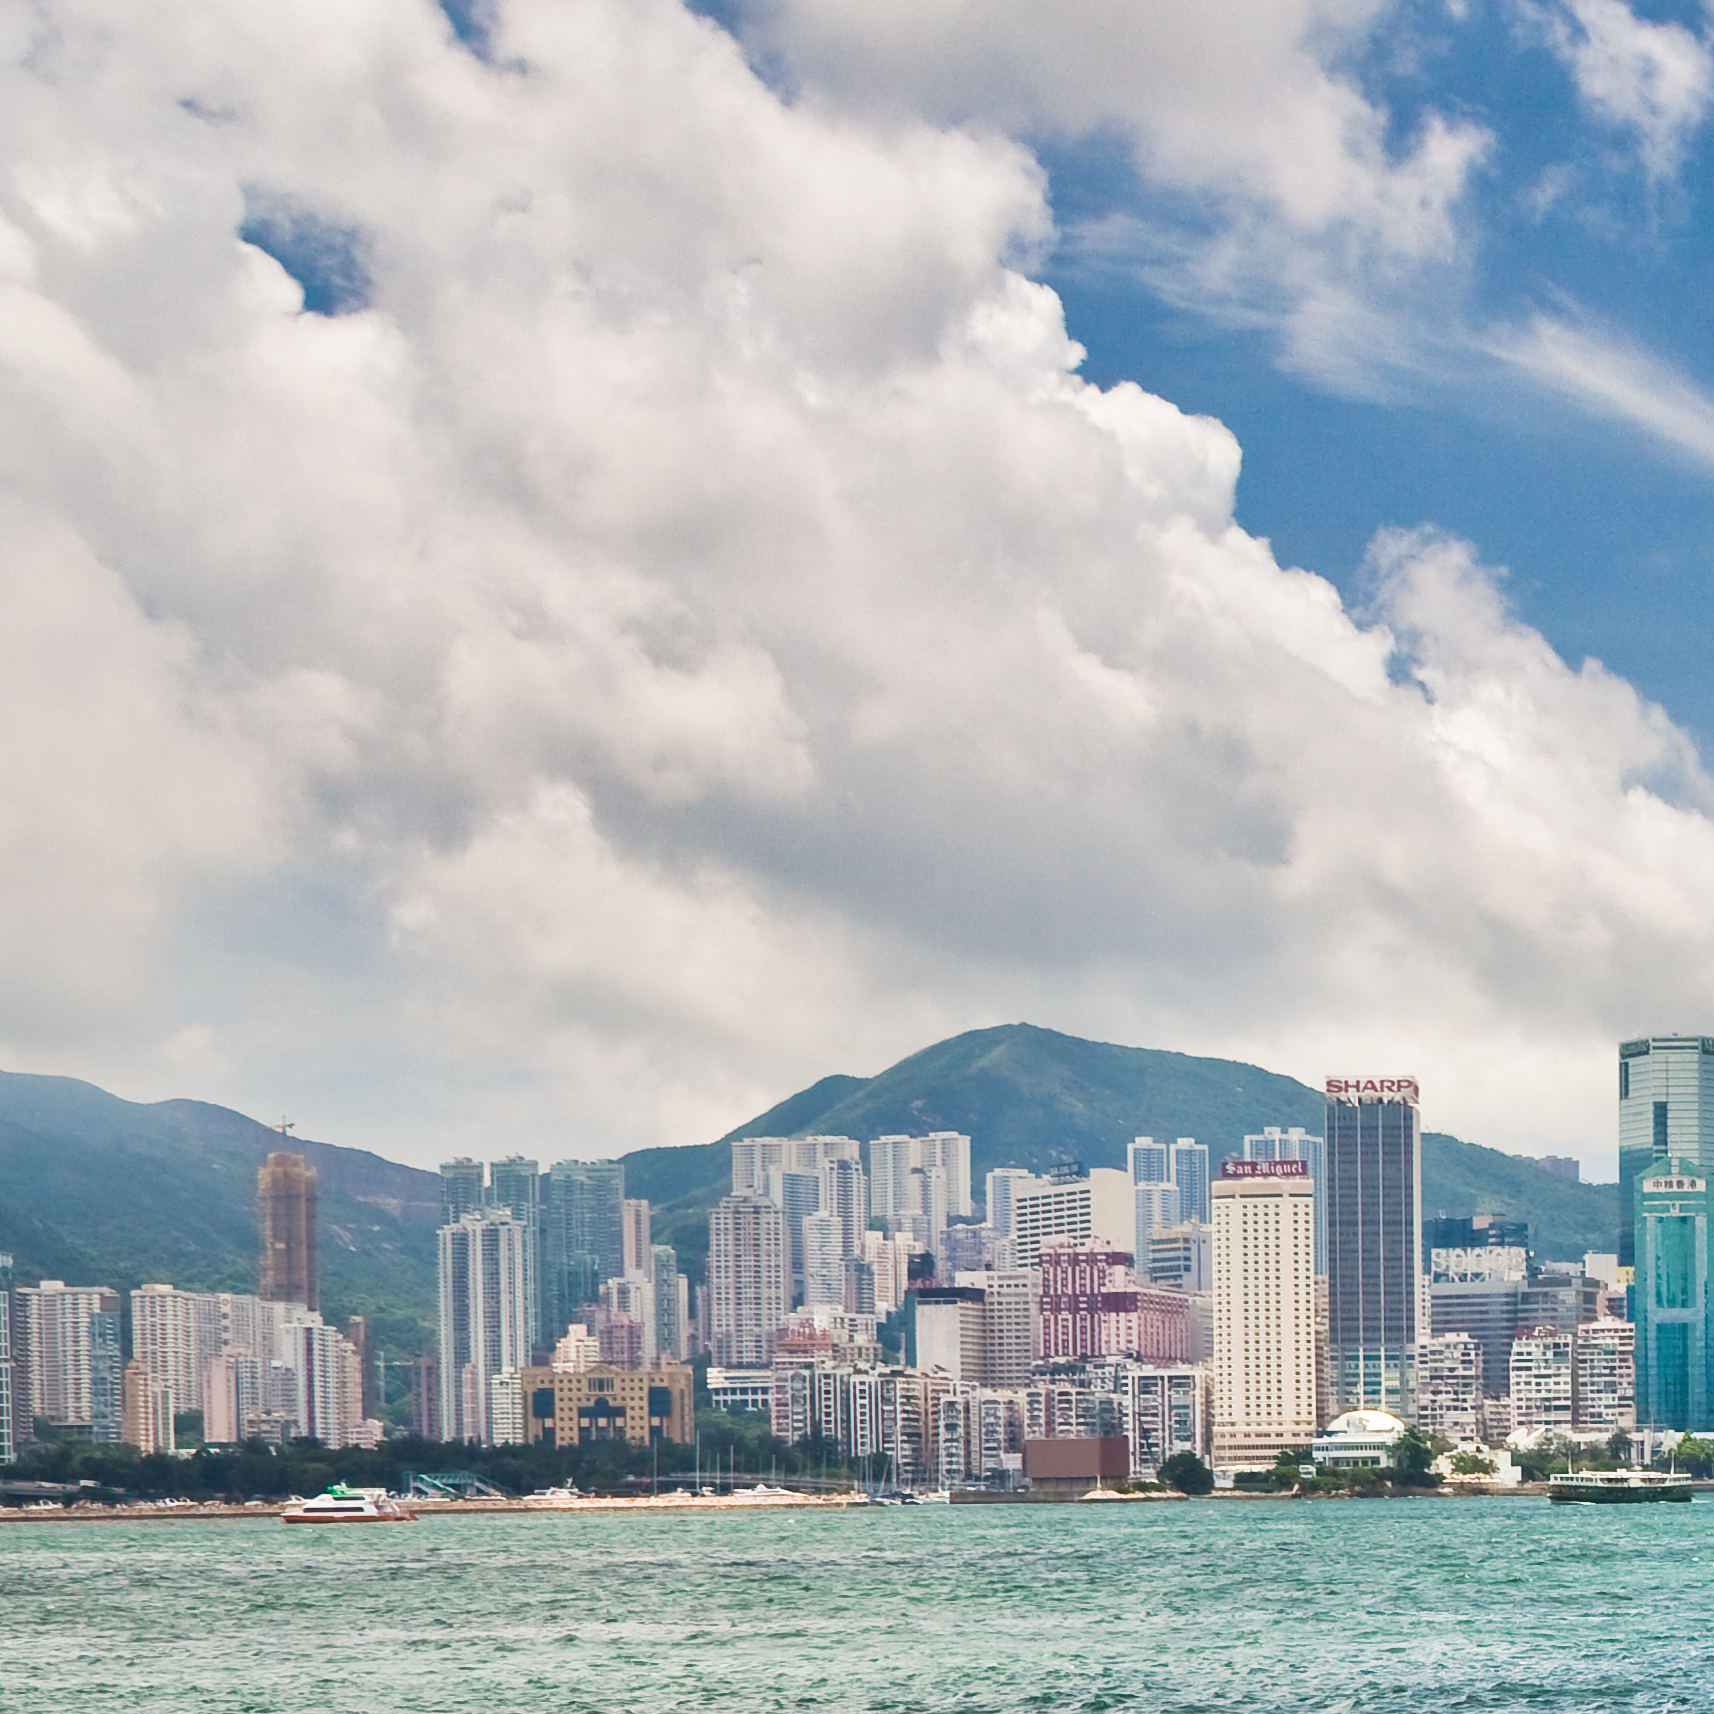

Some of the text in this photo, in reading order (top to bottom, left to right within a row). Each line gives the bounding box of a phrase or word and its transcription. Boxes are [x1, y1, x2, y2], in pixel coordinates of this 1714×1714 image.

[1326, 1079, 1412, 1093] SHARP
[1225, 1162, 1303, 1177] San Miguel
